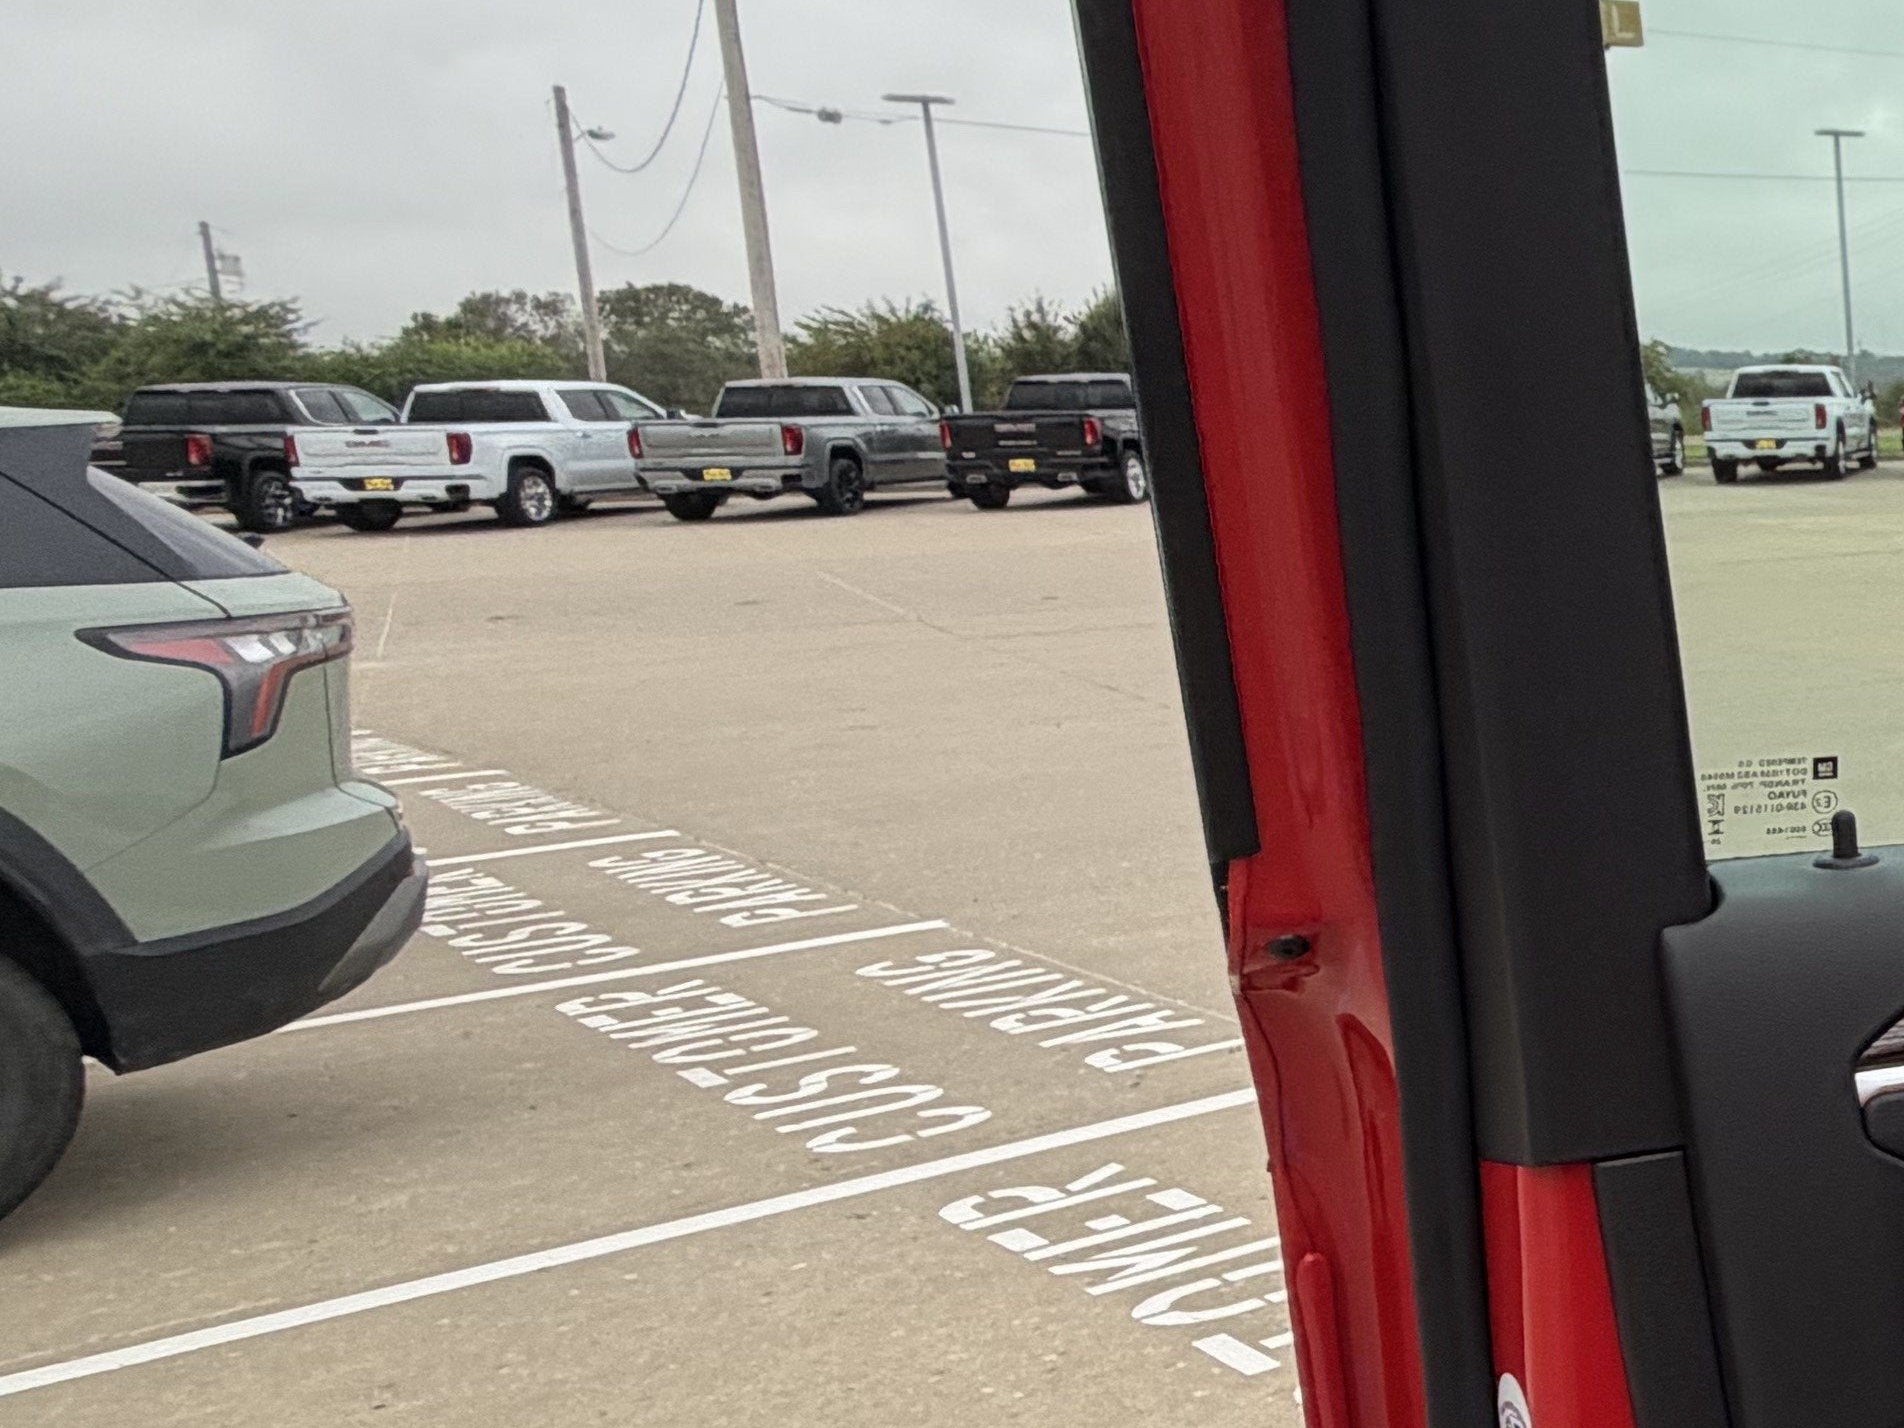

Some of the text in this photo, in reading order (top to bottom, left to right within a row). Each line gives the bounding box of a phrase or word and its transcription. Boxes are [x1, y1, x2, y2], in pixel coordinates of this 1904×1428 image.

[587, 848, 858, 927] PARKING
[554, 979, 993, 1153] CUSTOMER
[855, 949, 1246, 1073] PARKING
